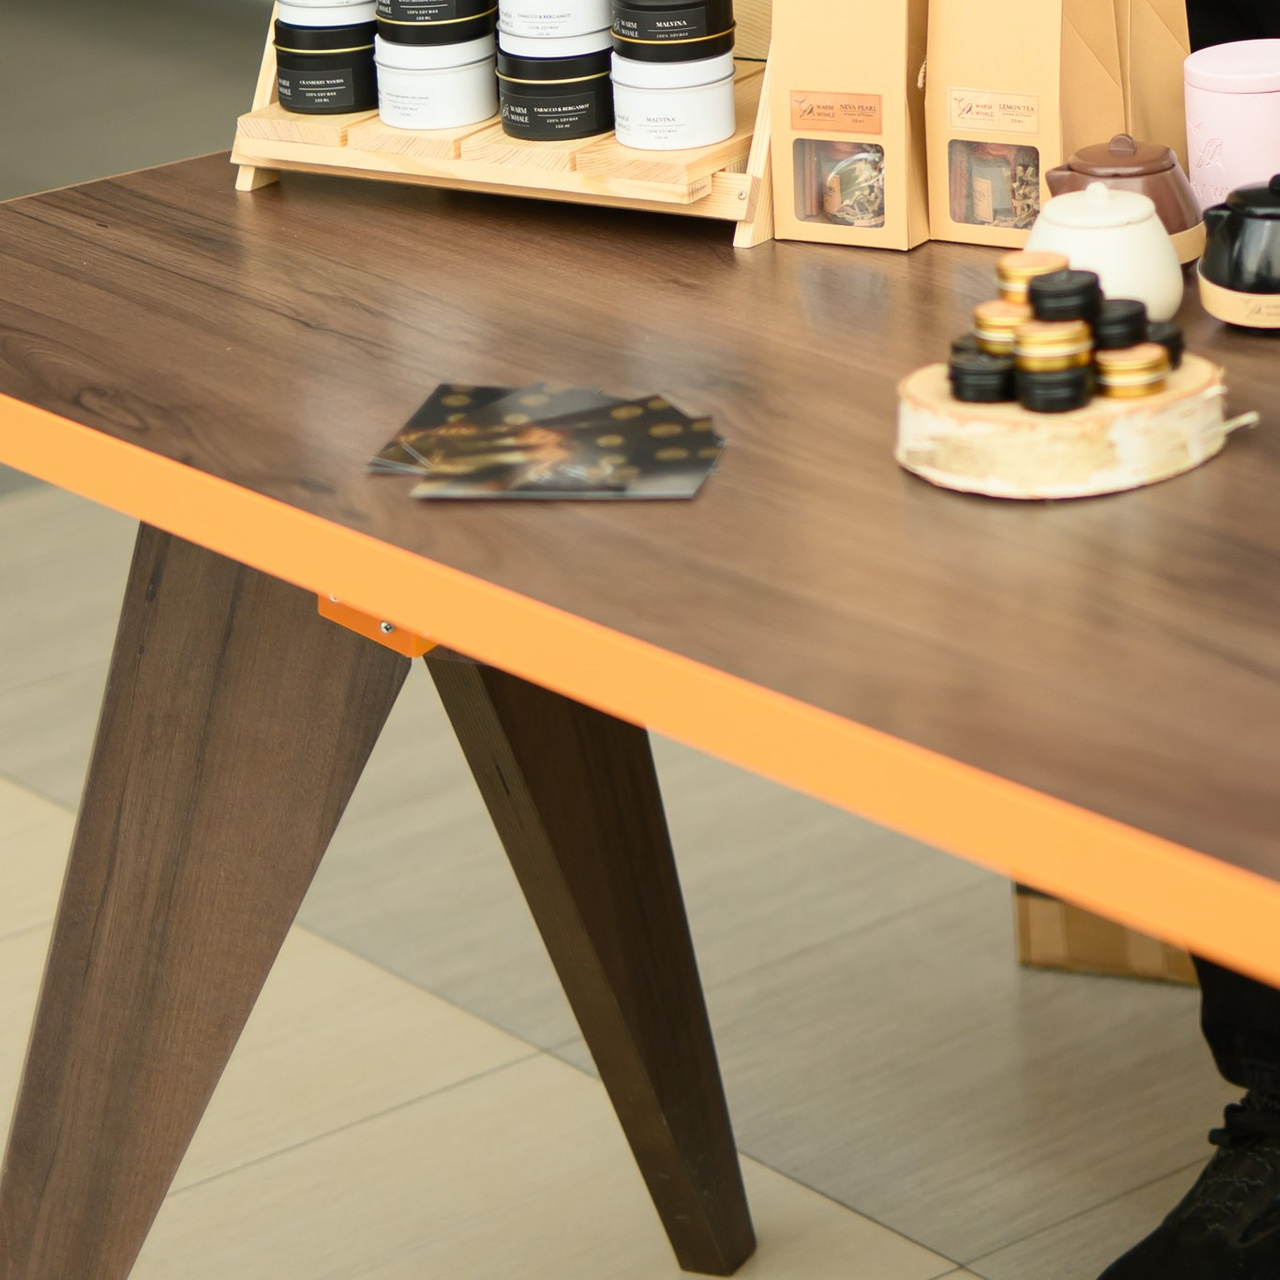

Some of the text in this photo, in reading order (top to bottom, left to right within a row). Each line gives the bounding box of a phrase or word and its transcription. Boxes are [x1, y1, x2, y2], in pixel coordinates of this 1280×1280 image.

[620, 19, 637, 29] WARM
[655, 20, 687, 28] MALVINA
[621, 28, 639, 38] WHALE
[510, 105, 527, 114] WARM
[562, 103, 590, 111] BERGAMOT
[857, 104, 877, 112] PEARL
[998, 104, 1022, 112] LEMON
[510, 114, 529, 123] WHALE
